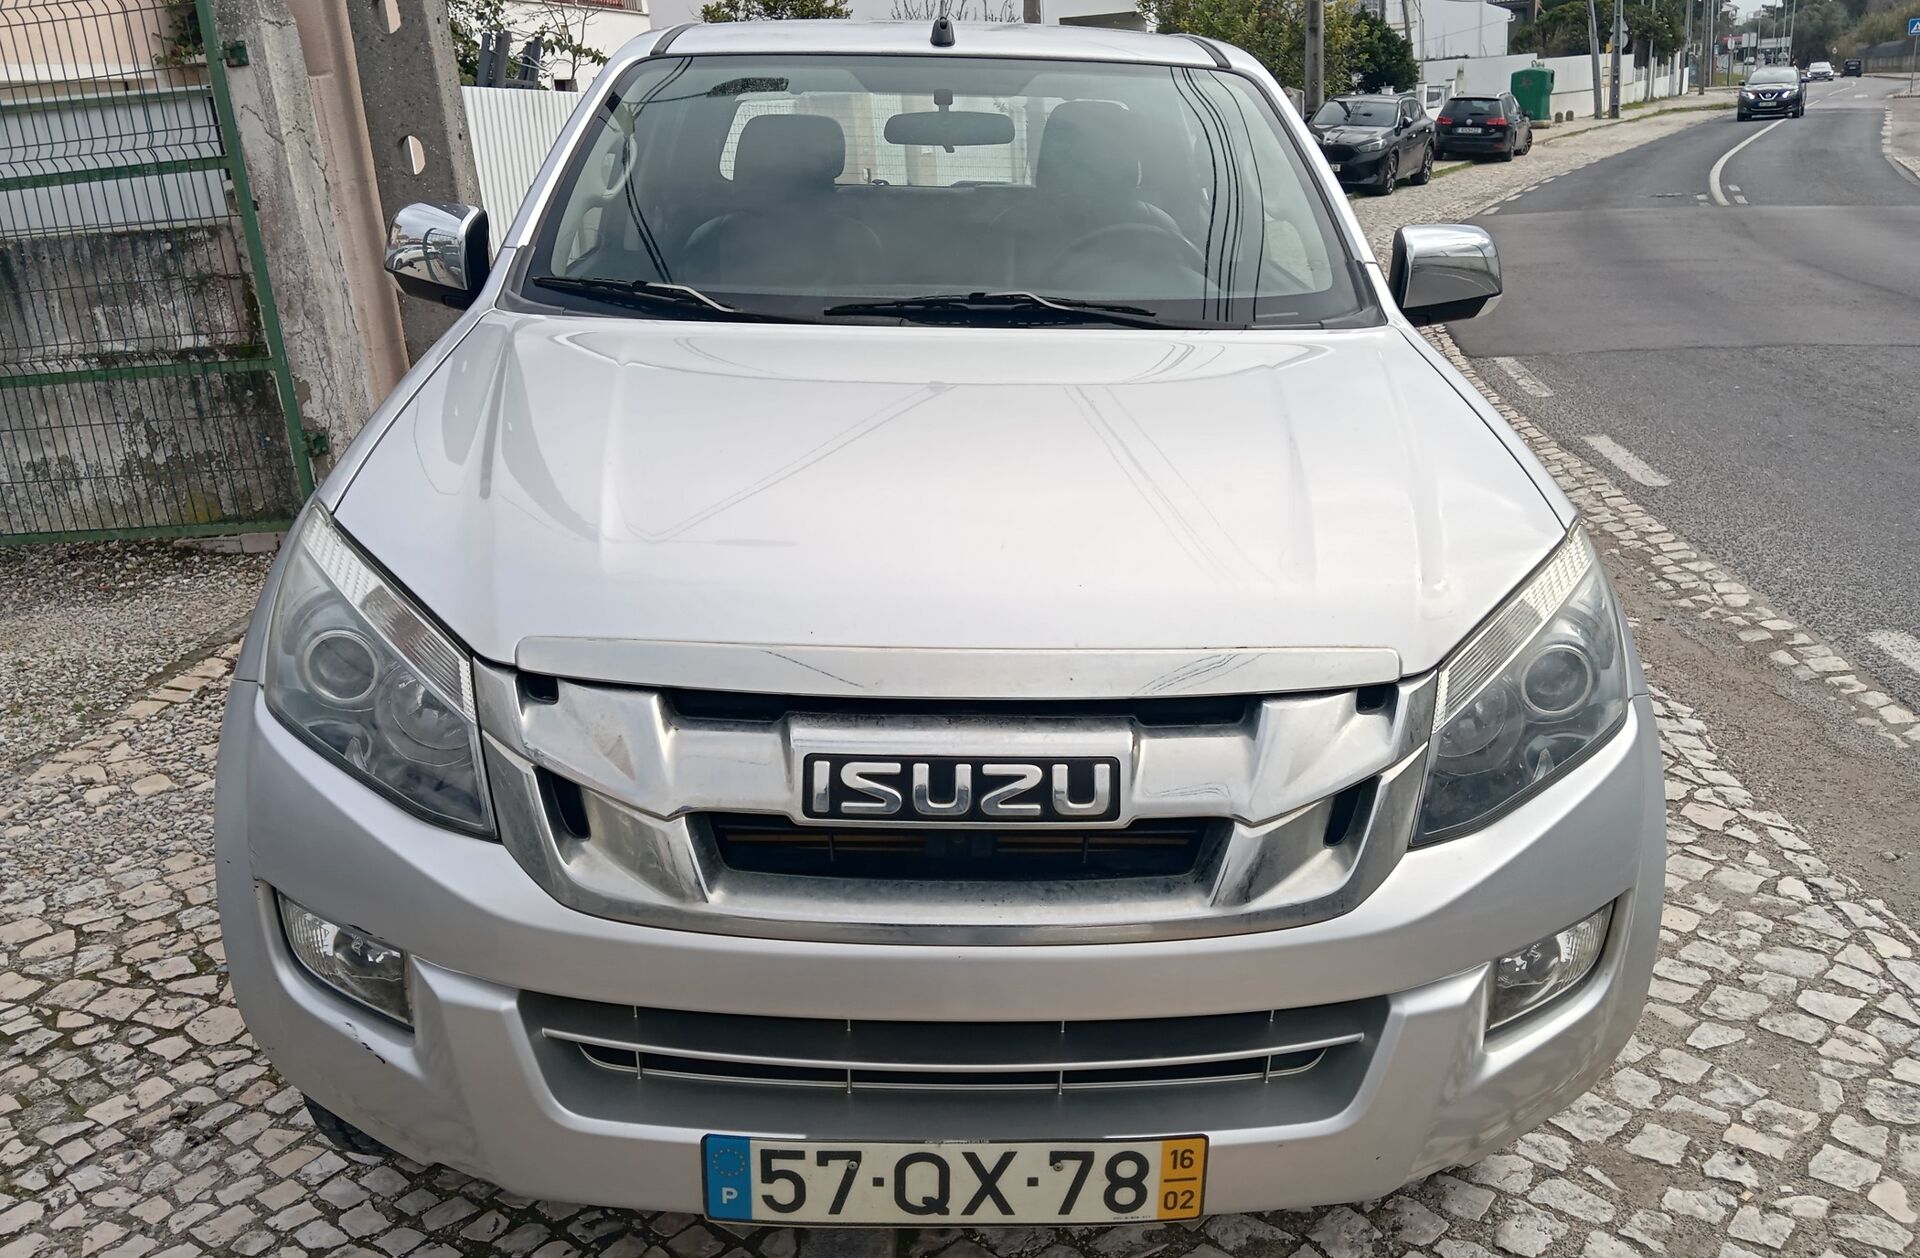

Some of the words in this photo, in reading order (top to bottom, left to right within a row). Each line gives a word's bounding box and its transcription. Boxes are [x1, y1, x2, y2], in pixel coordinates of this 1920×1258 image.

[812, 760, 1111, 816] ISUZU
[1170, 1148, 1195, 1170] 16
[721, 1186, 738, 1205] P
[1163, 1189, 1195, 1211] 02
